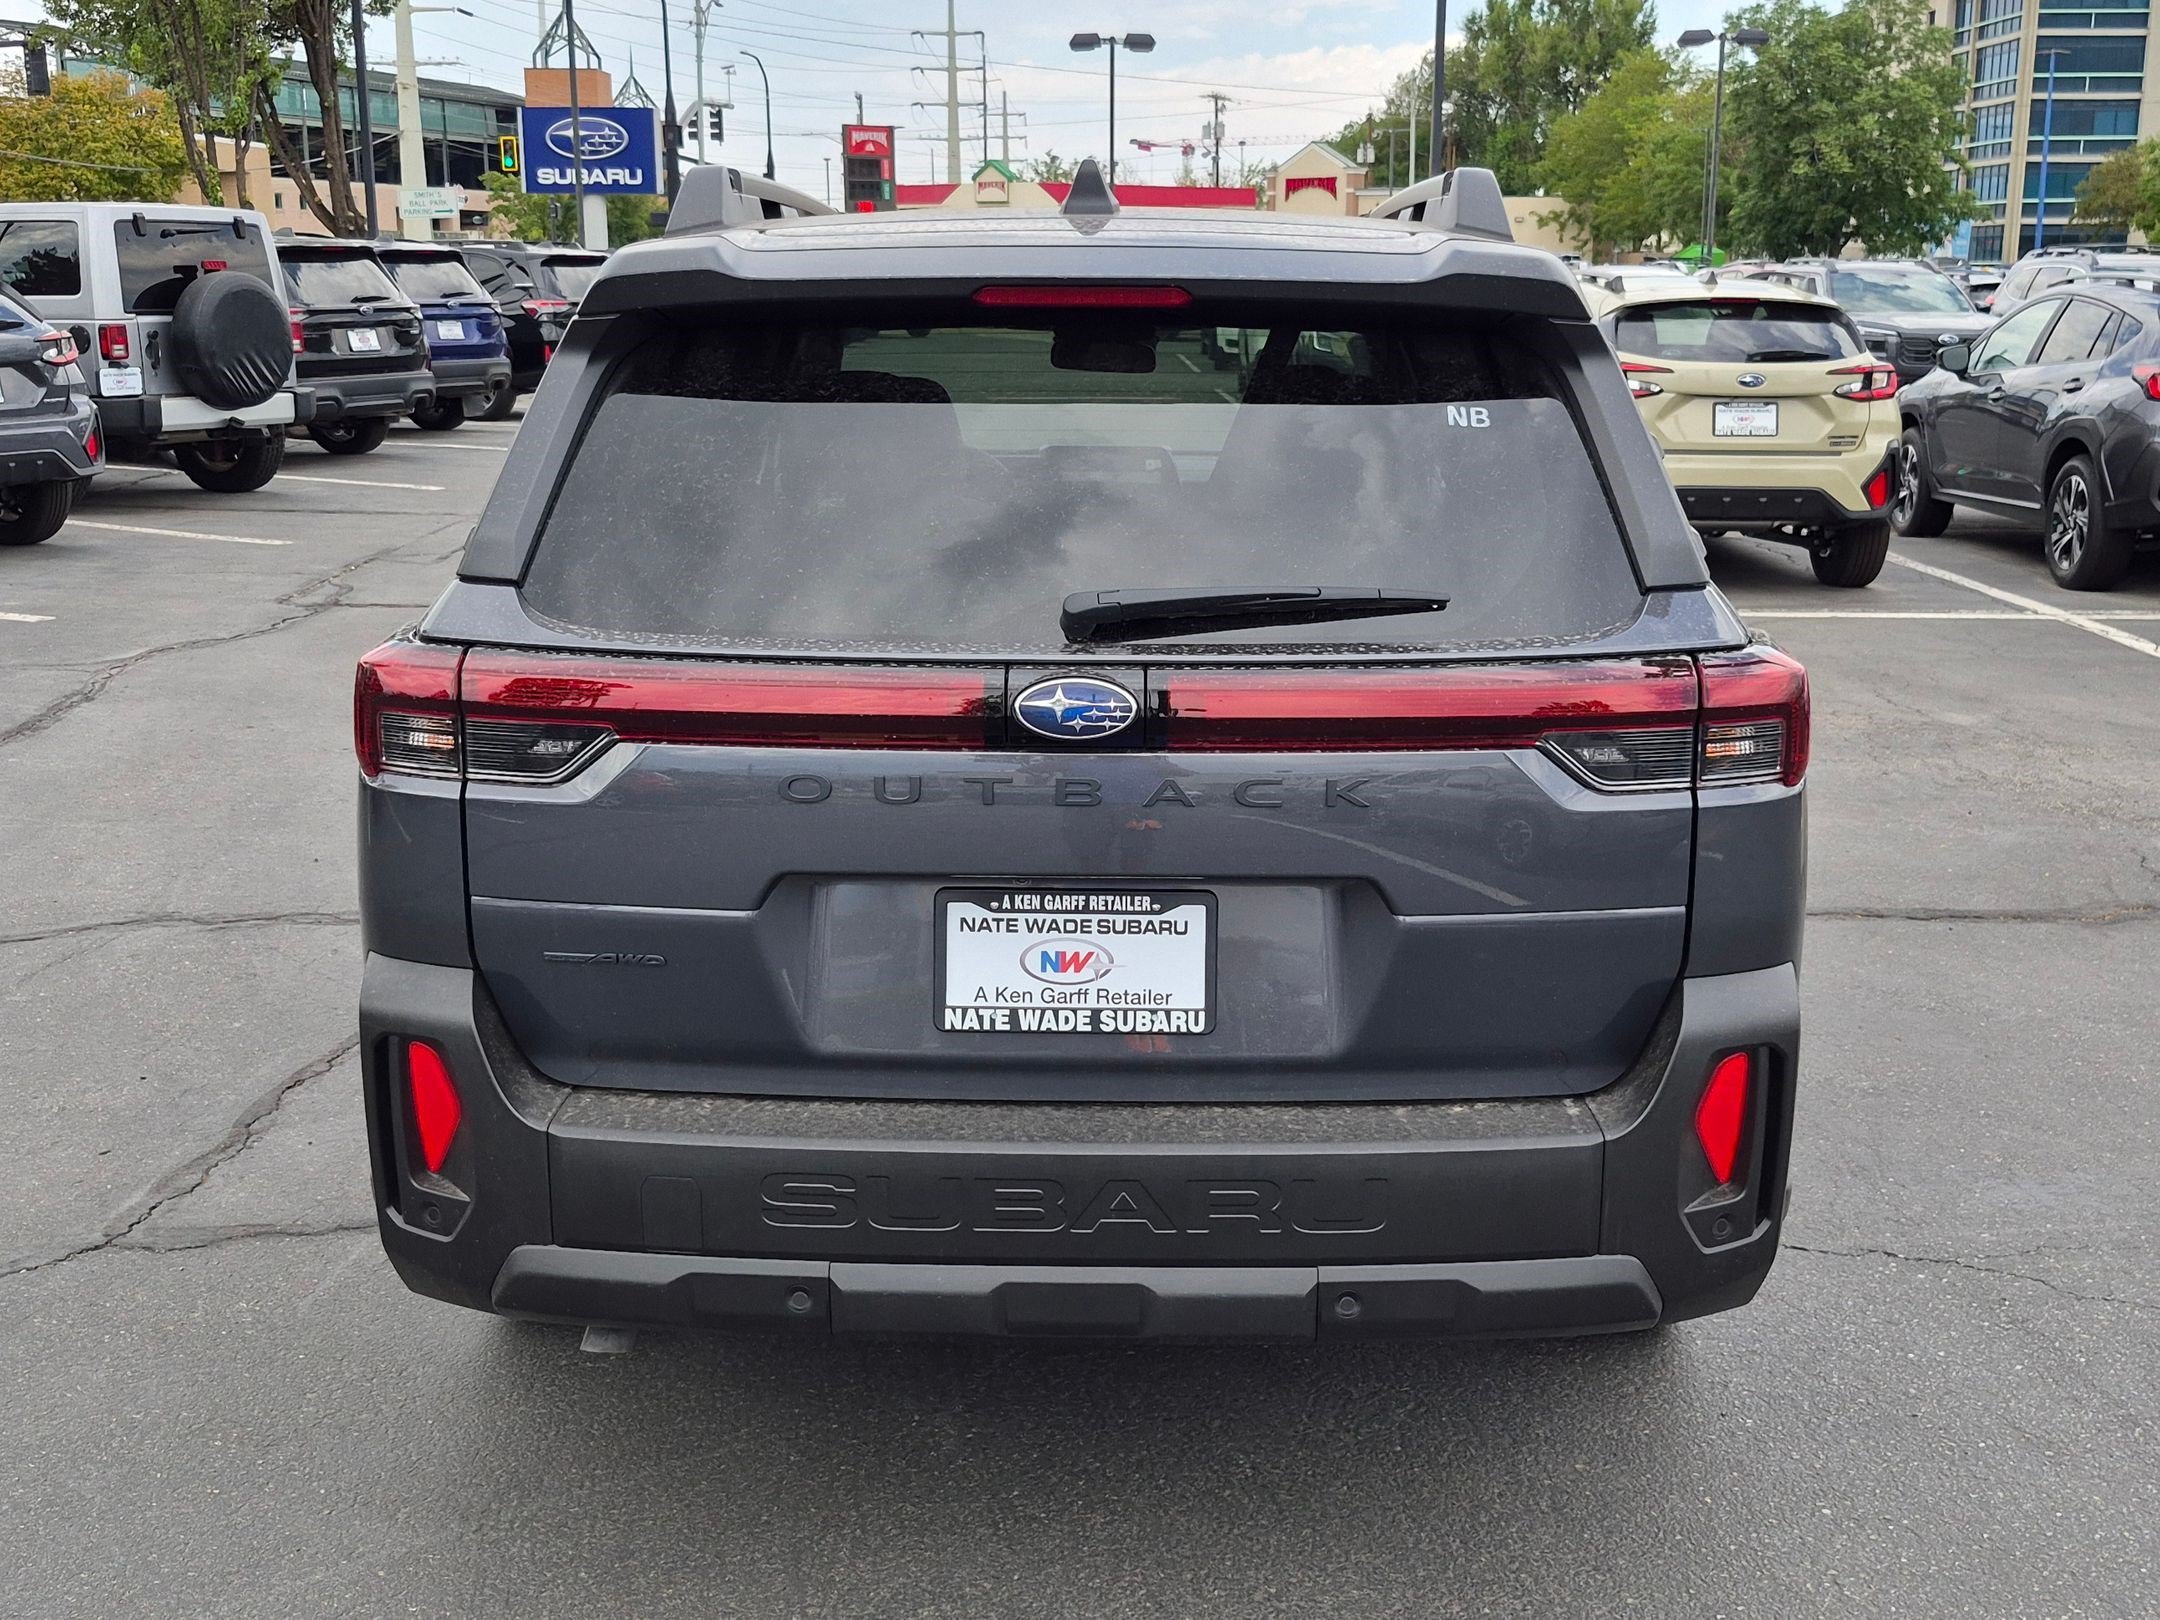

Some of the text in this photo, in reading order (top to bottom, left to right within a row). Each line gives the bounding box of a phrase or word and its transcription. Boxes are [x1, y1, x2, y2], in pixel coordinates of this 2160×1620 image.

[537, 168, 643, 185] SUBARU
[403, 208, 433, 216] PARKING
[430, 199, 448, 207] PARK
[1447, 405, 1491, 428] NB
[779, 774, 1370, 808] OUTBACK
[1002, 894, 1151, 912] A KEN GARFF RETAILER
[960, 917, 1188, 936] NATE WADE SUBARU
[1040, 950, 1095, 973] NW
[974, 987, 1172, 1006] A Ken Garff Retailer
[945, 1008, 1205, 1033] NATE WADE SUBARU
[761, 1172, 1389, 1235] SUBARU
